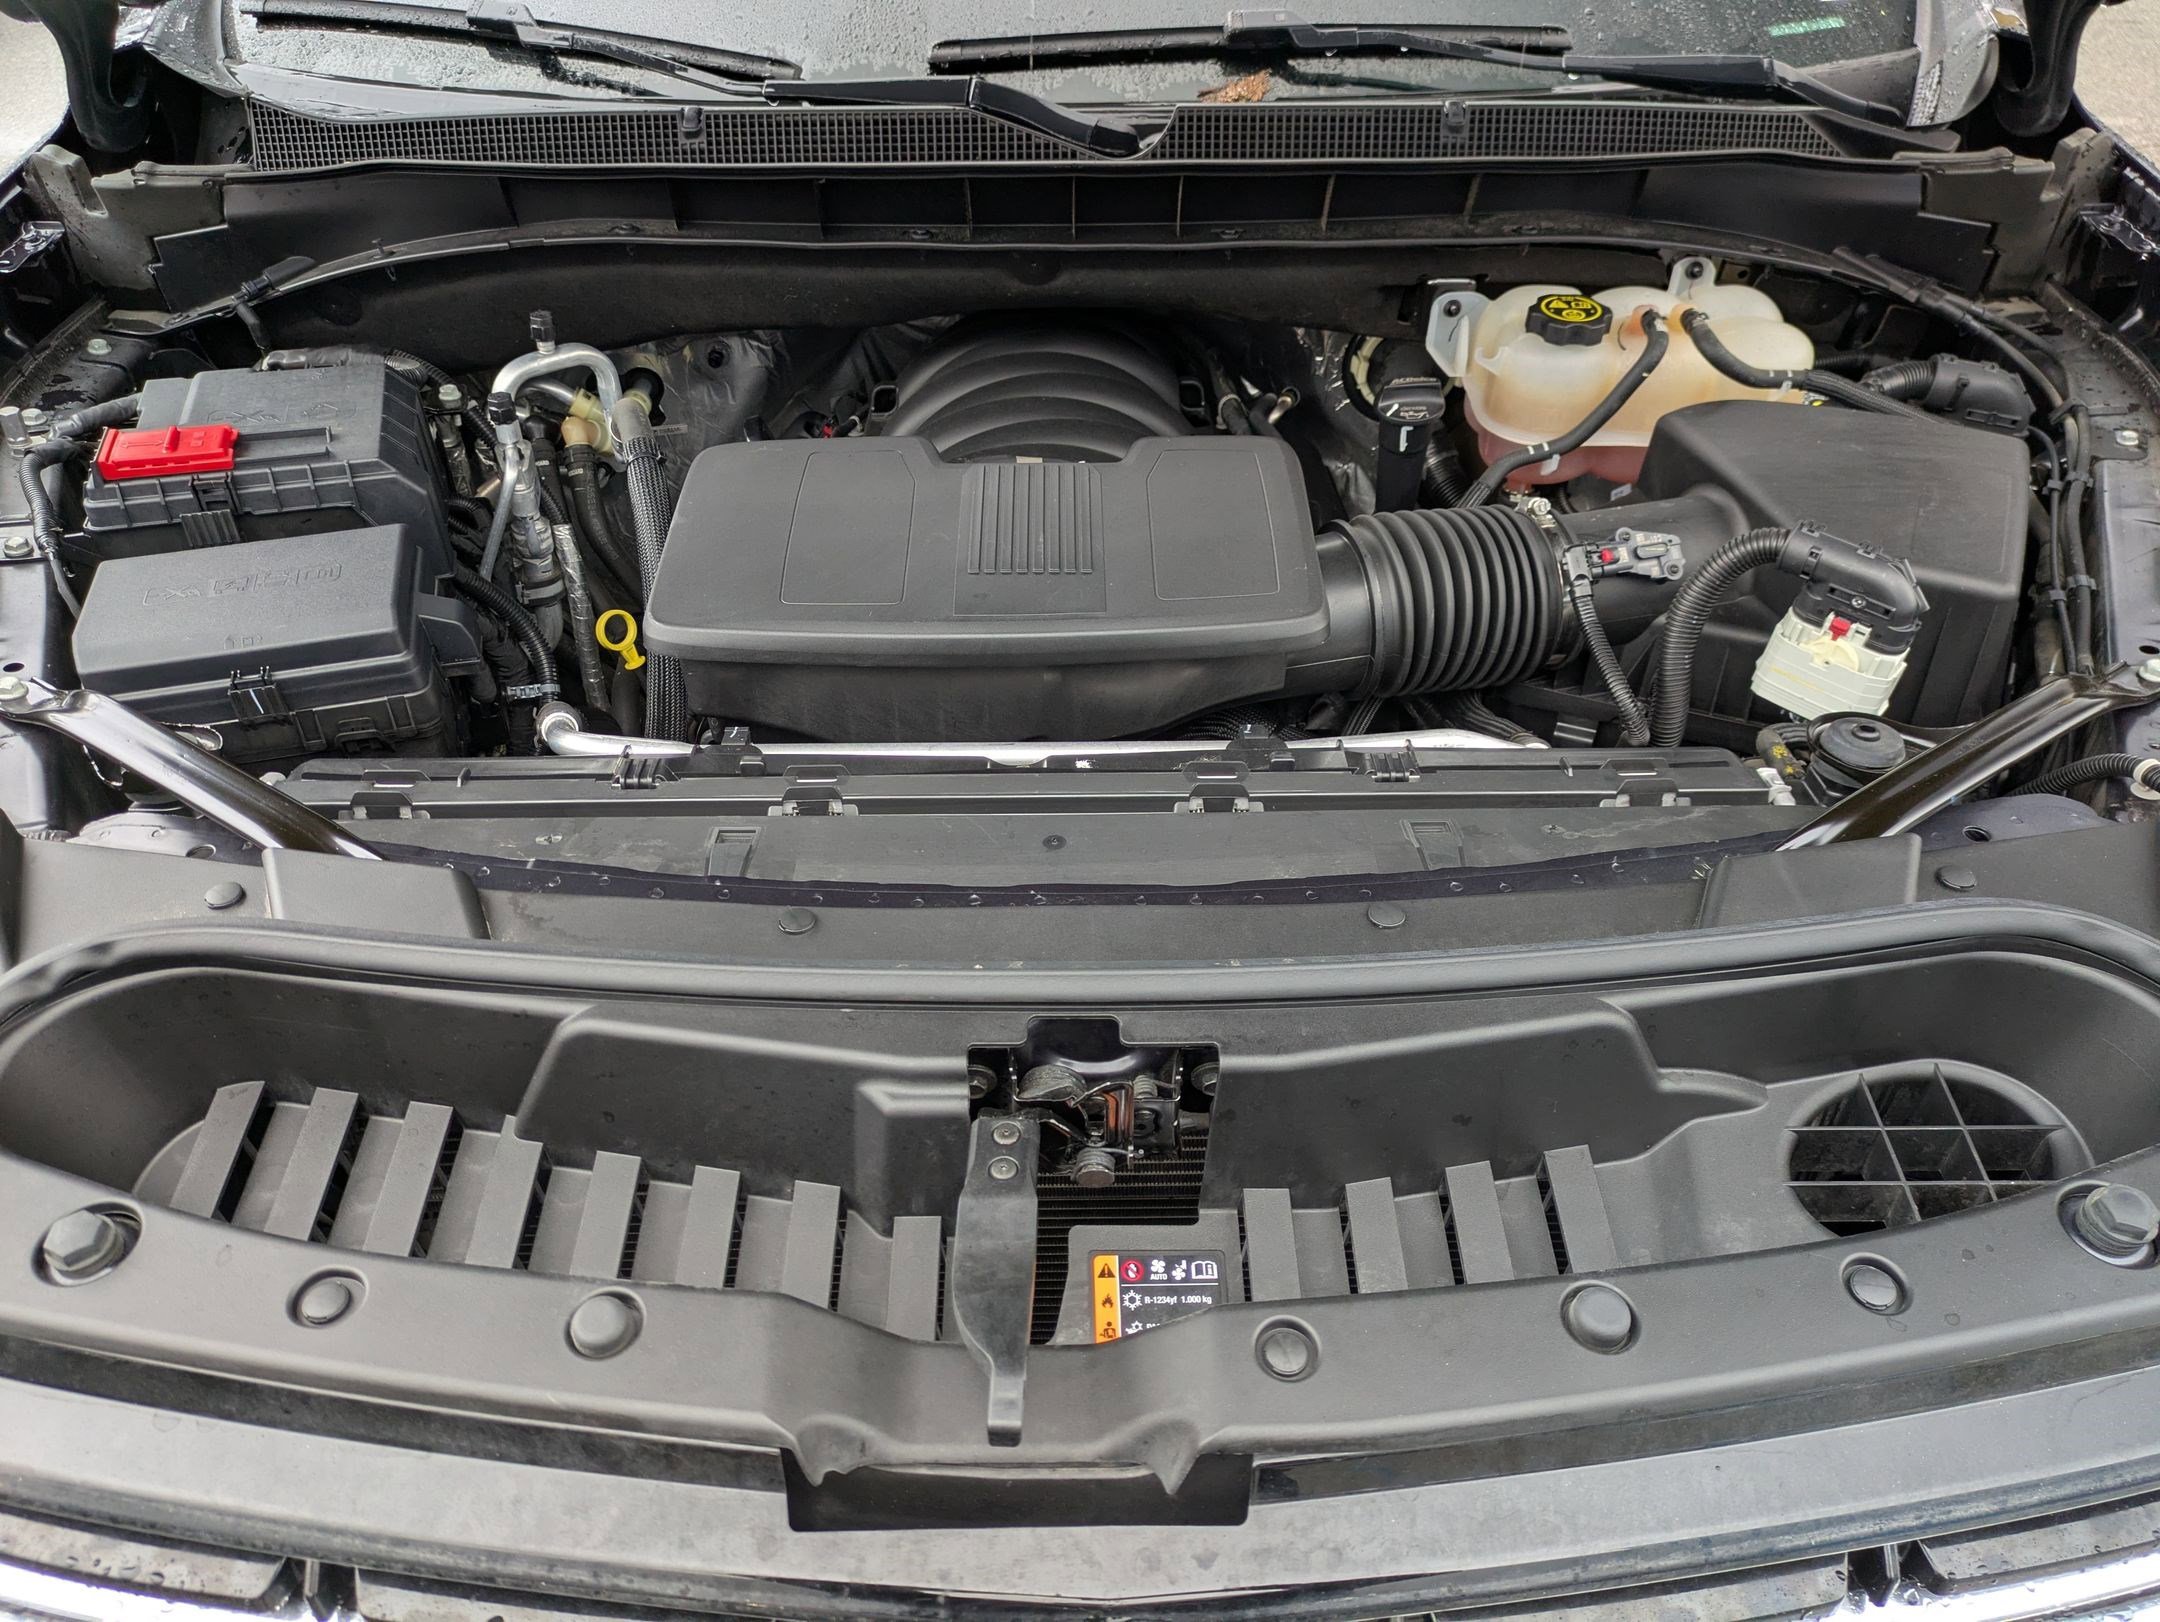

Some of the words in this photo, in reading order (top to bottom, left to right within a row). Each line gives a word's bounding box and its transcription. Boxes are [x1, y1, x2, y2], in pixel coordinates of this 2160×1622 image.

[1144, 1295, 1178, 1305] R-1234yf
[1181, 1295, 1201, 1304] 1.000
[1202, 1295, 1212, 1305] kg
